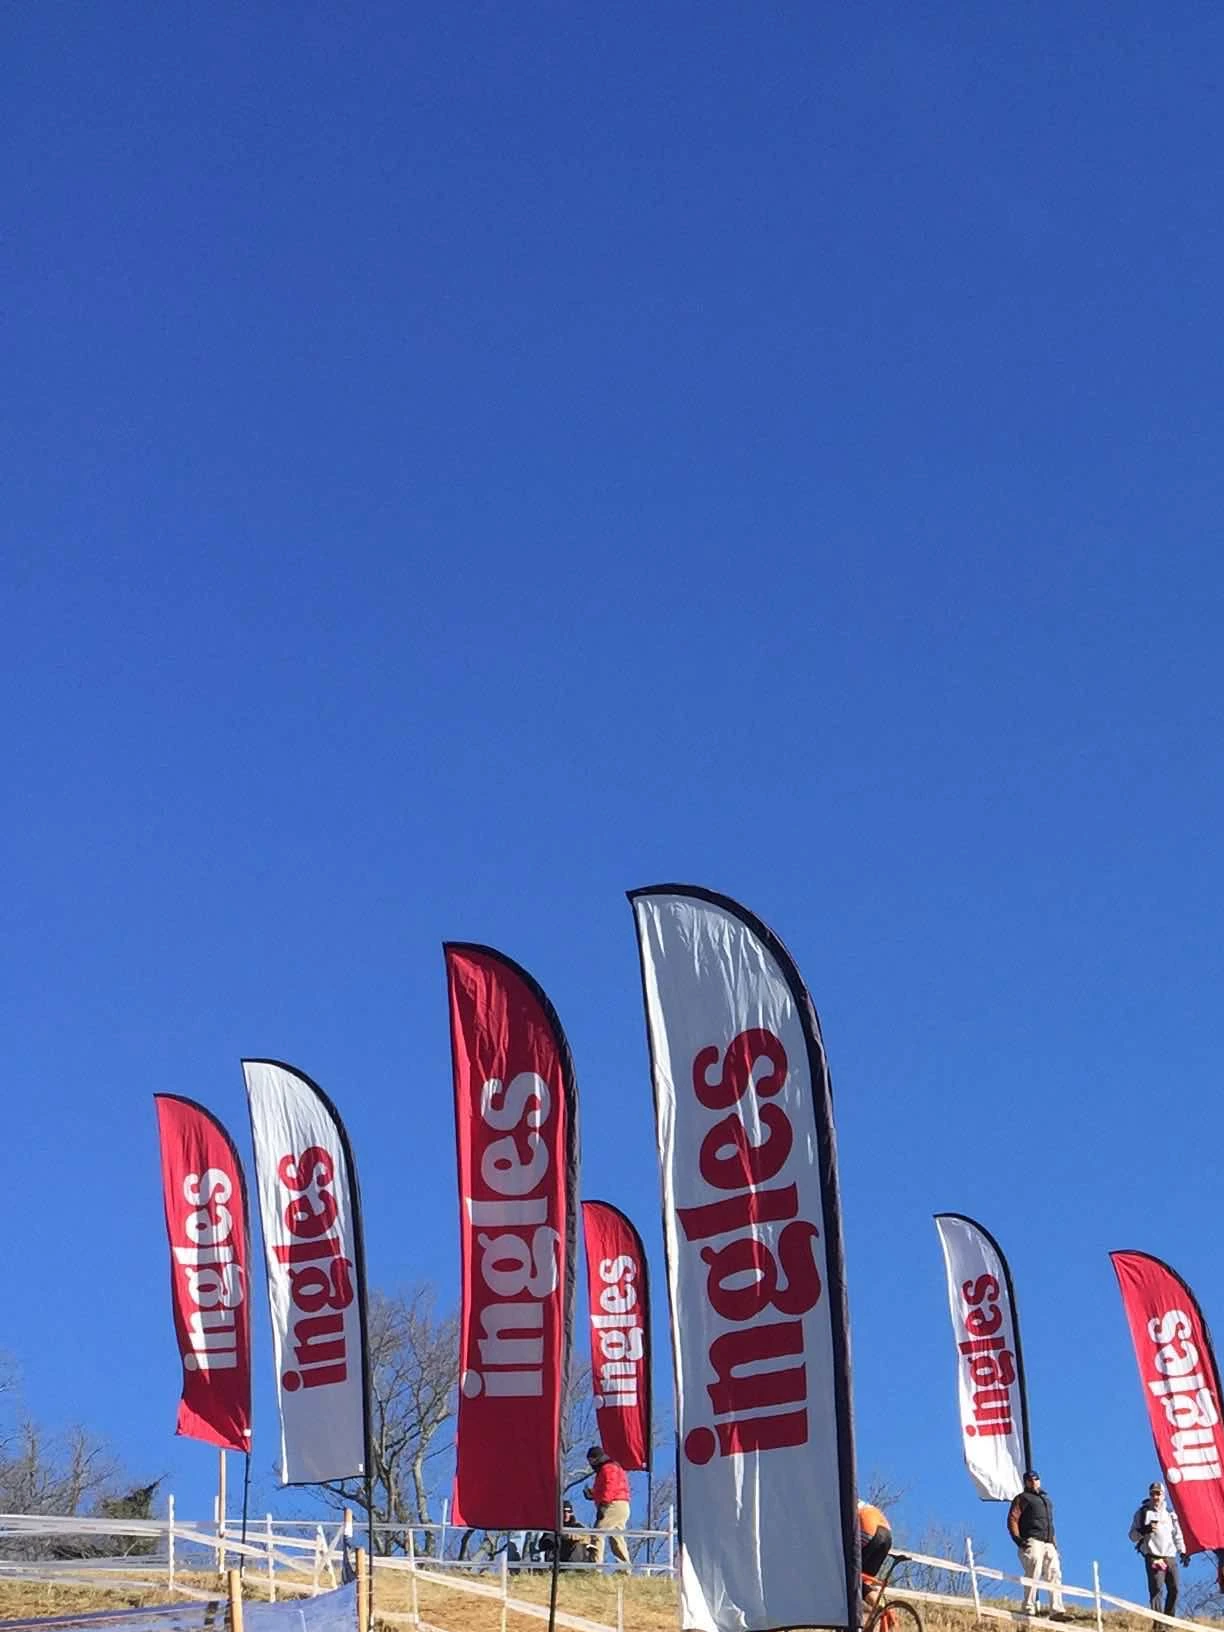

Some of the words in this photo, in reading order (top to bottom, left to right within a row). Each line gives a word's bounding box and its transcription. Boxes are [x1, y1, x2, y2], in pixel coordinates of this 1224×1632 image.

[171, 1167, 245, 1373] ingles
[270, 1145, 354, 1393] ingles
[461, 1072, 560, 1400] ingles
[590, 1255, 646, 1408] ingles
[678, 1027, 821, 1466] ingles
[958, 1273, 1015, 1438] ingles
[1149, 1308, 1222, 1486] ingles
